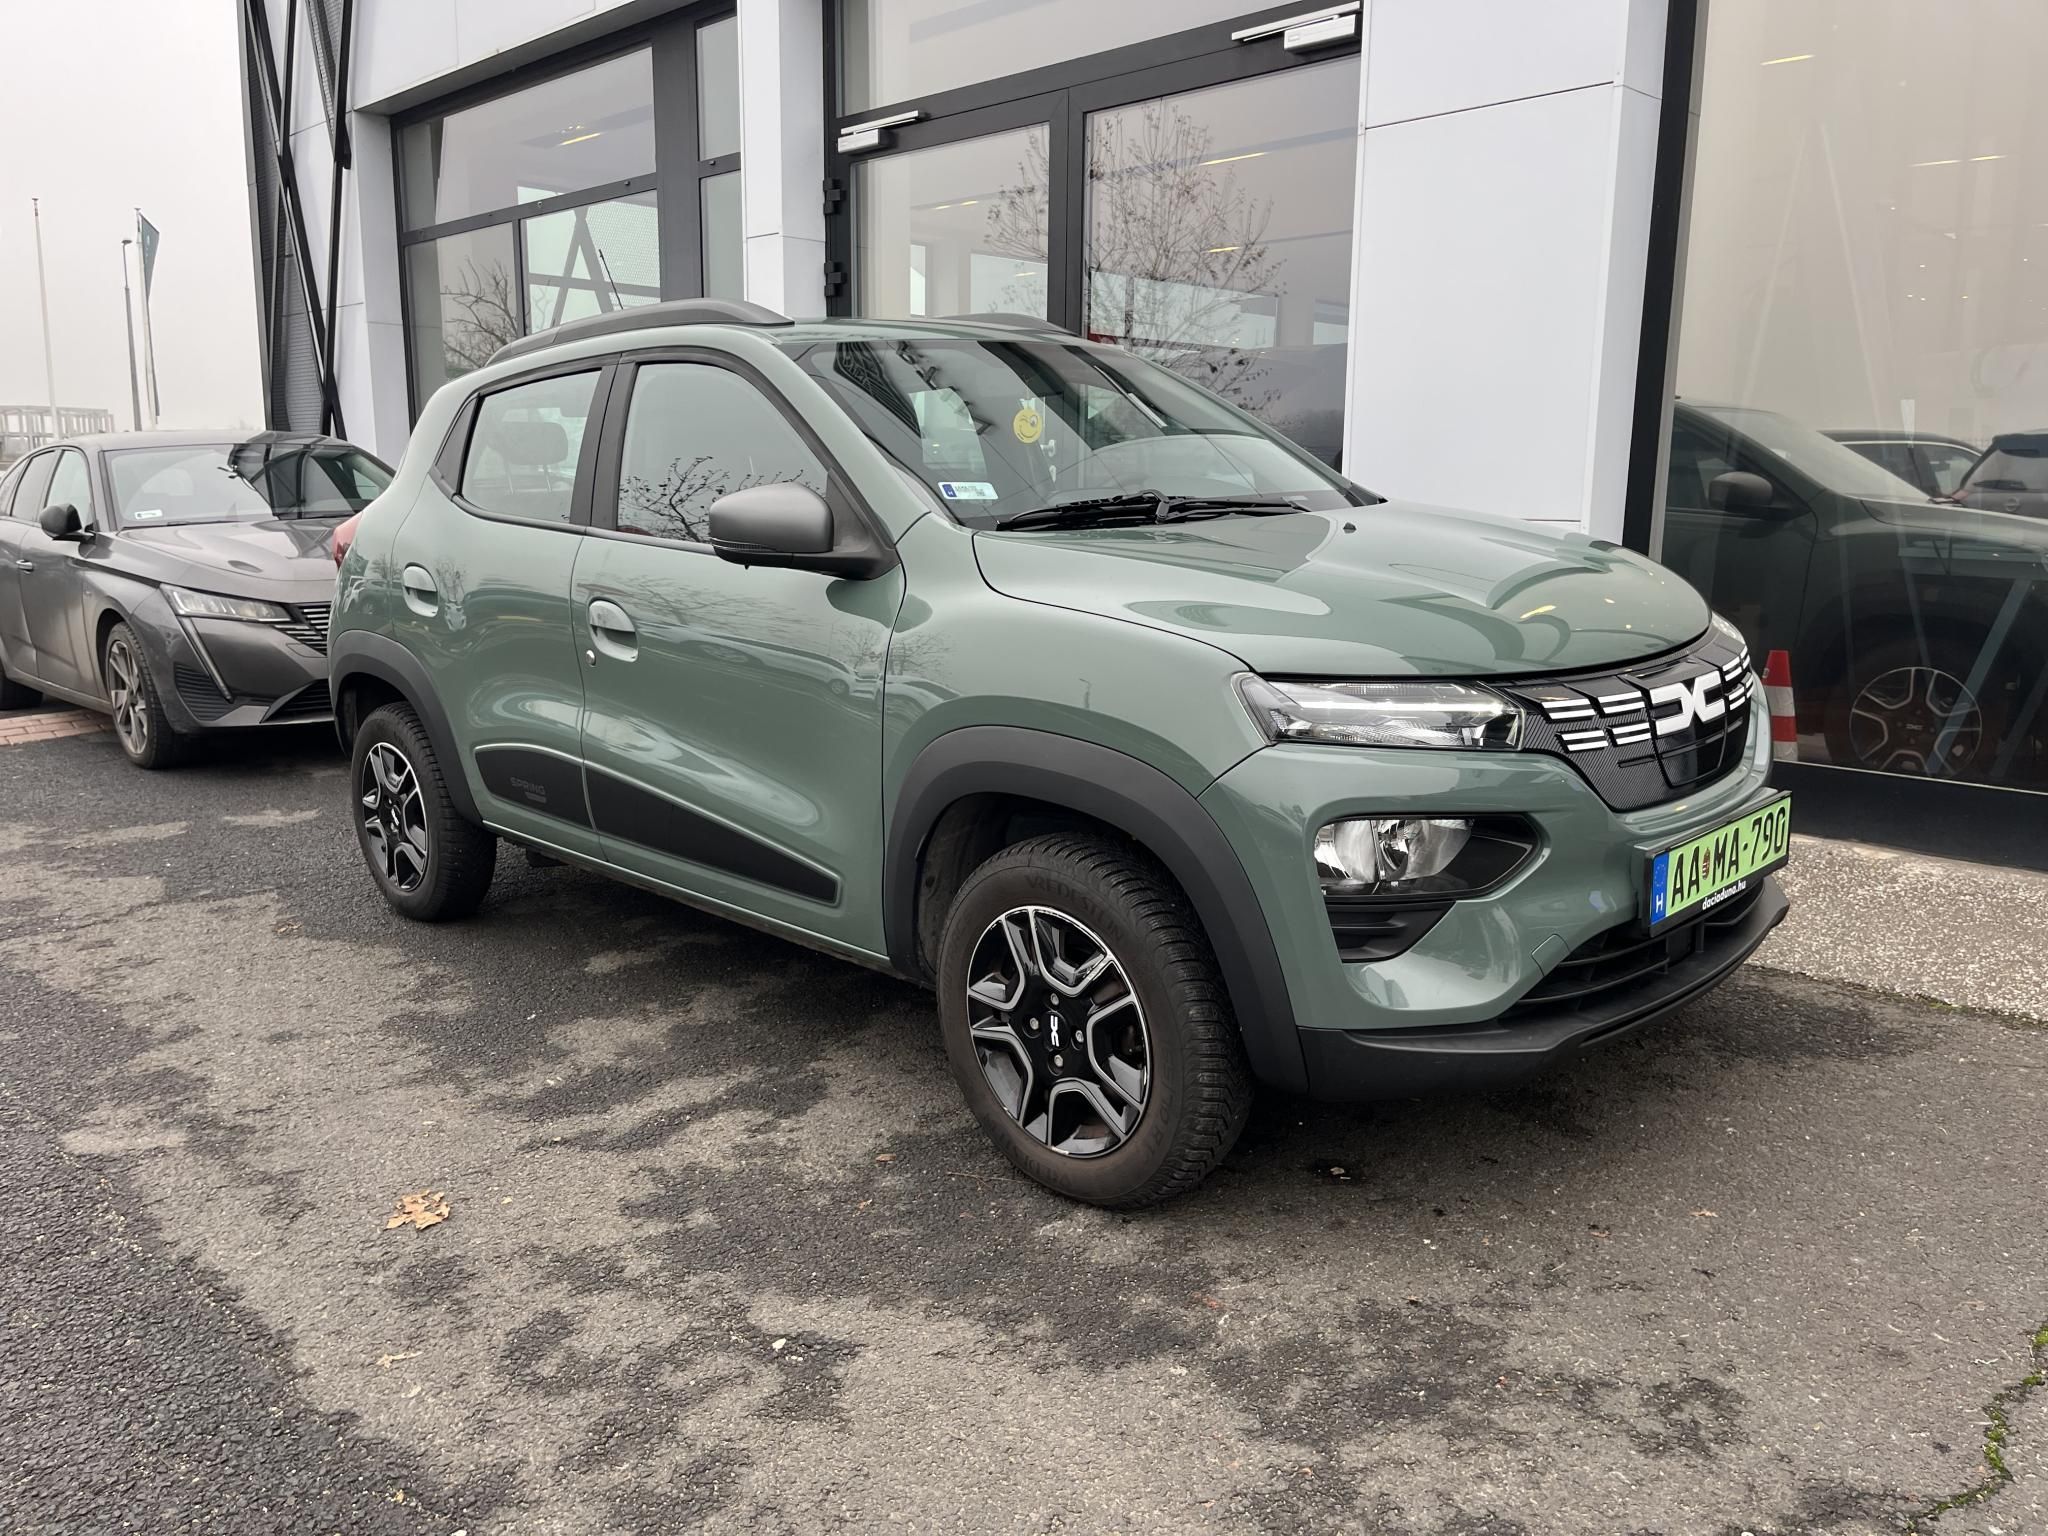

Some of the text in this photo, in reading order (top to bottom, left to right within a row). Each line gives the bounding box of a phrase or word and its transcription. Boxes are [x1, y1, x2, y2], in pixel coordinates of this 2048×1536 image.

[1671, 845, 1700, 907] AA
[1655, 892, 1664, 914] H
[1702, 879, 1747, 910] daciaduna.hu
